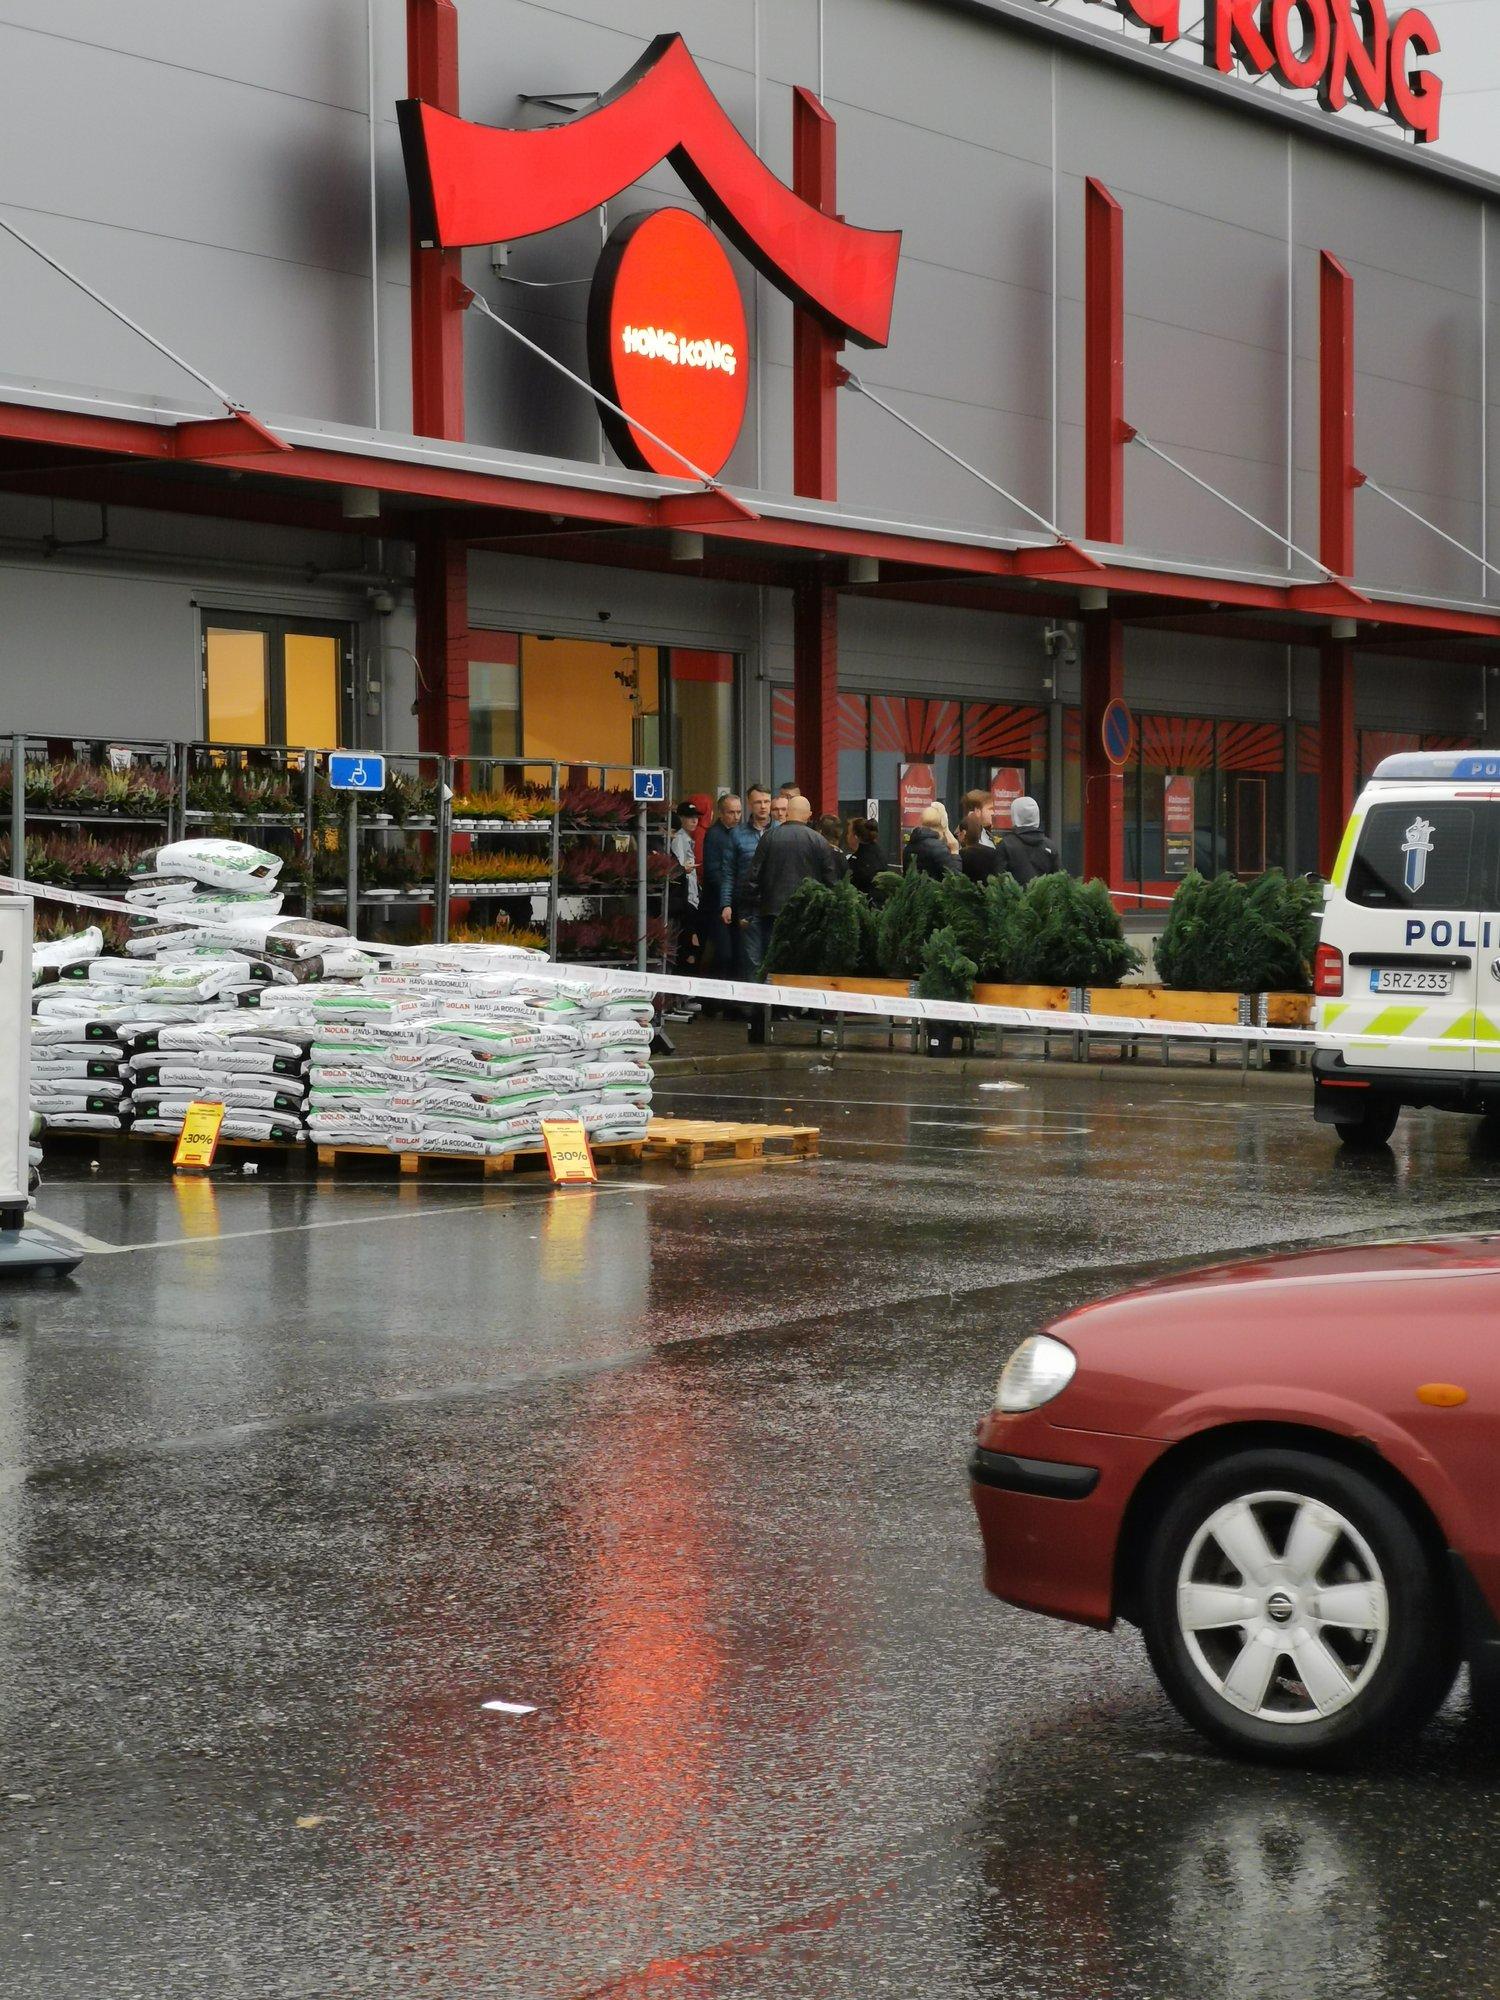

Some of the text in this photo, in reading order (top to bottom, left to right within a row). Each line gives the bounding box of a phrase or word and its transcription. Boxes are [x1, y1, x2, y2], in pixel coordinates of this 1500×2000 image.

[1210, 0, 1442, 143] KONG
[622, 325, 736, 375] HONG KONG
[1406, 920, 1500, 948] POLI
[1383, 973, 1448, 989] SRZ-233
[183, 1133, 213, 1145] -30%
[552, 1151, 588, 1161] -30%
